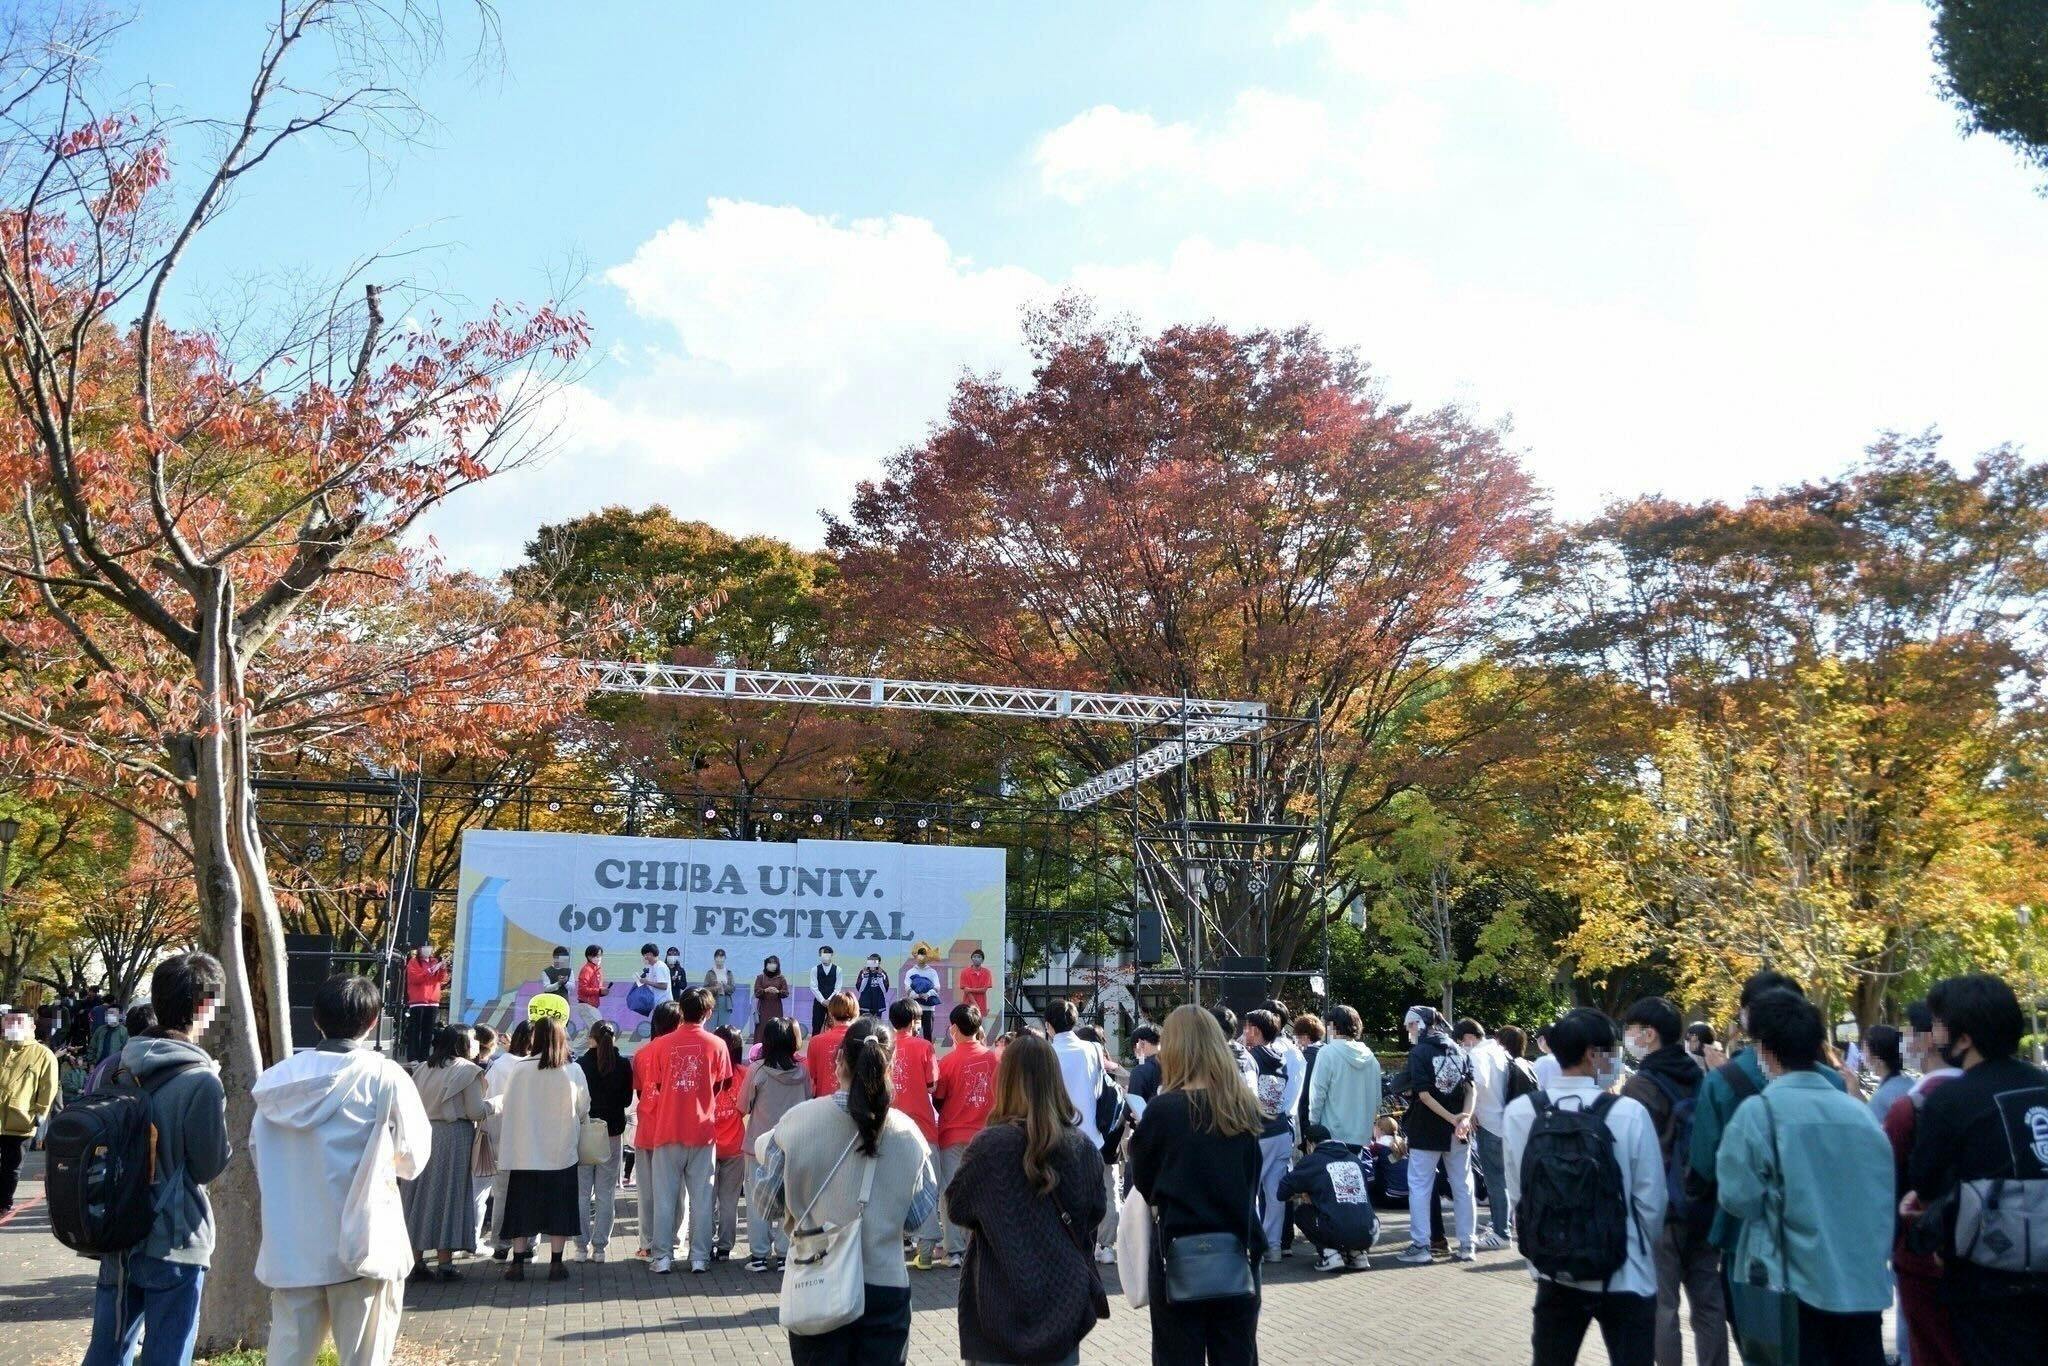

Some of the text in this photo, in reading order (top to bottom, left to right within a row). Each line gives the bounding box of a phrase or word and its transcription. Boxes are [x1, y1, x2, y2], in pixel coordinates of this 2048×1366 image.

[595, 858, 884, 899] CHIBA UNIV.
[559, 902, 915, 941] 60TH FESTIVAL
